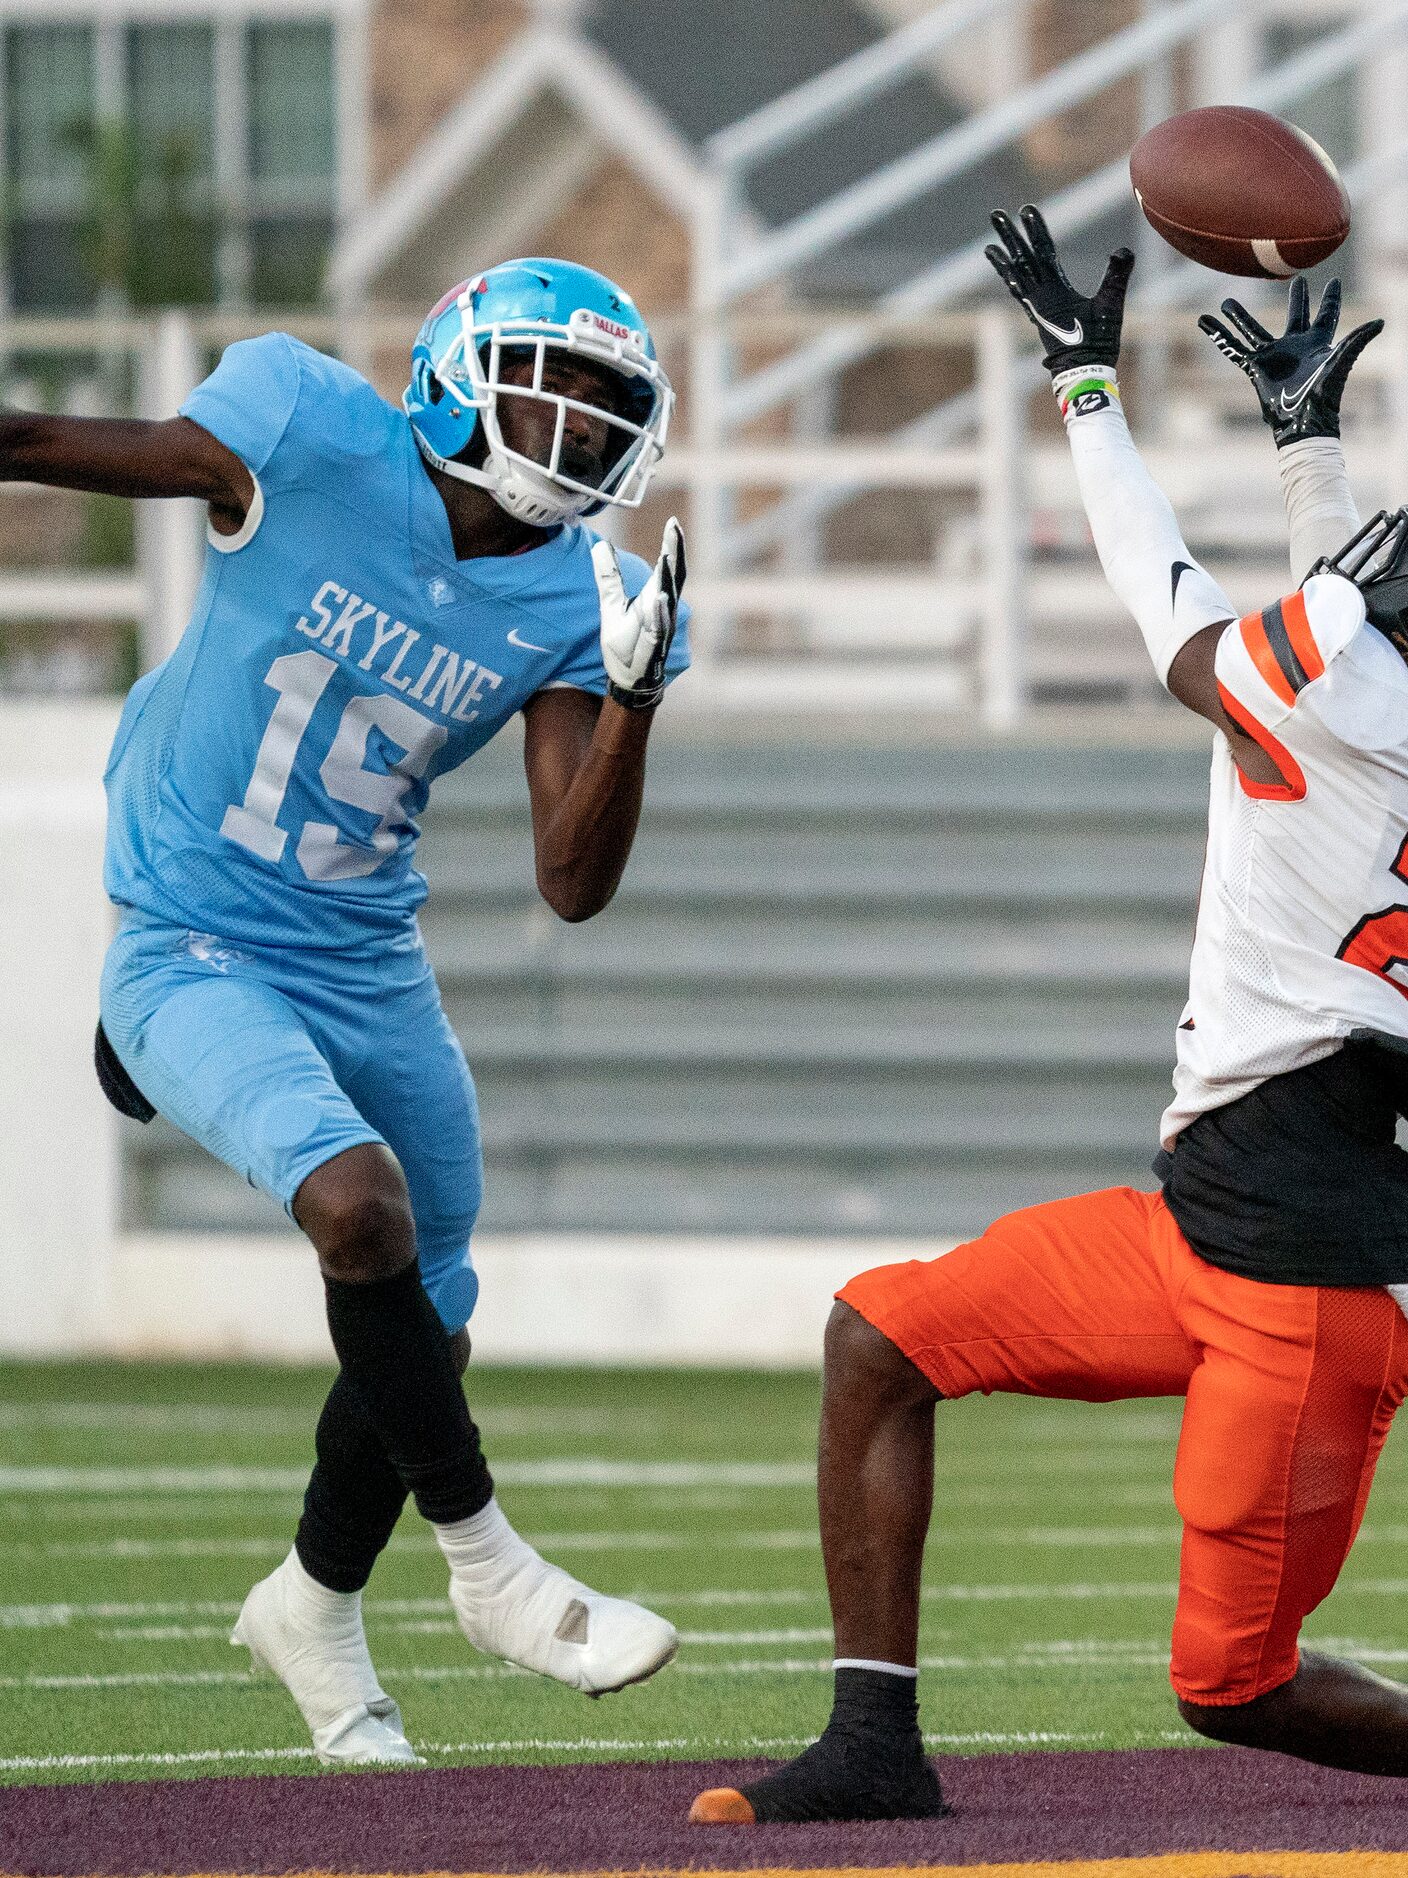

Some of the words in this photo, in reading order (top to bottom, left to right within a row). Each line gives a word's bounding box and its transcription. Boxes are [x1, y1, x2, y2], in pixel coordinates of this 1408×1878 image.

[608, 294, 621, 312] 2
[295, 580, 503, 723] SKYLINE
[219, 649, 448, 882] 19
